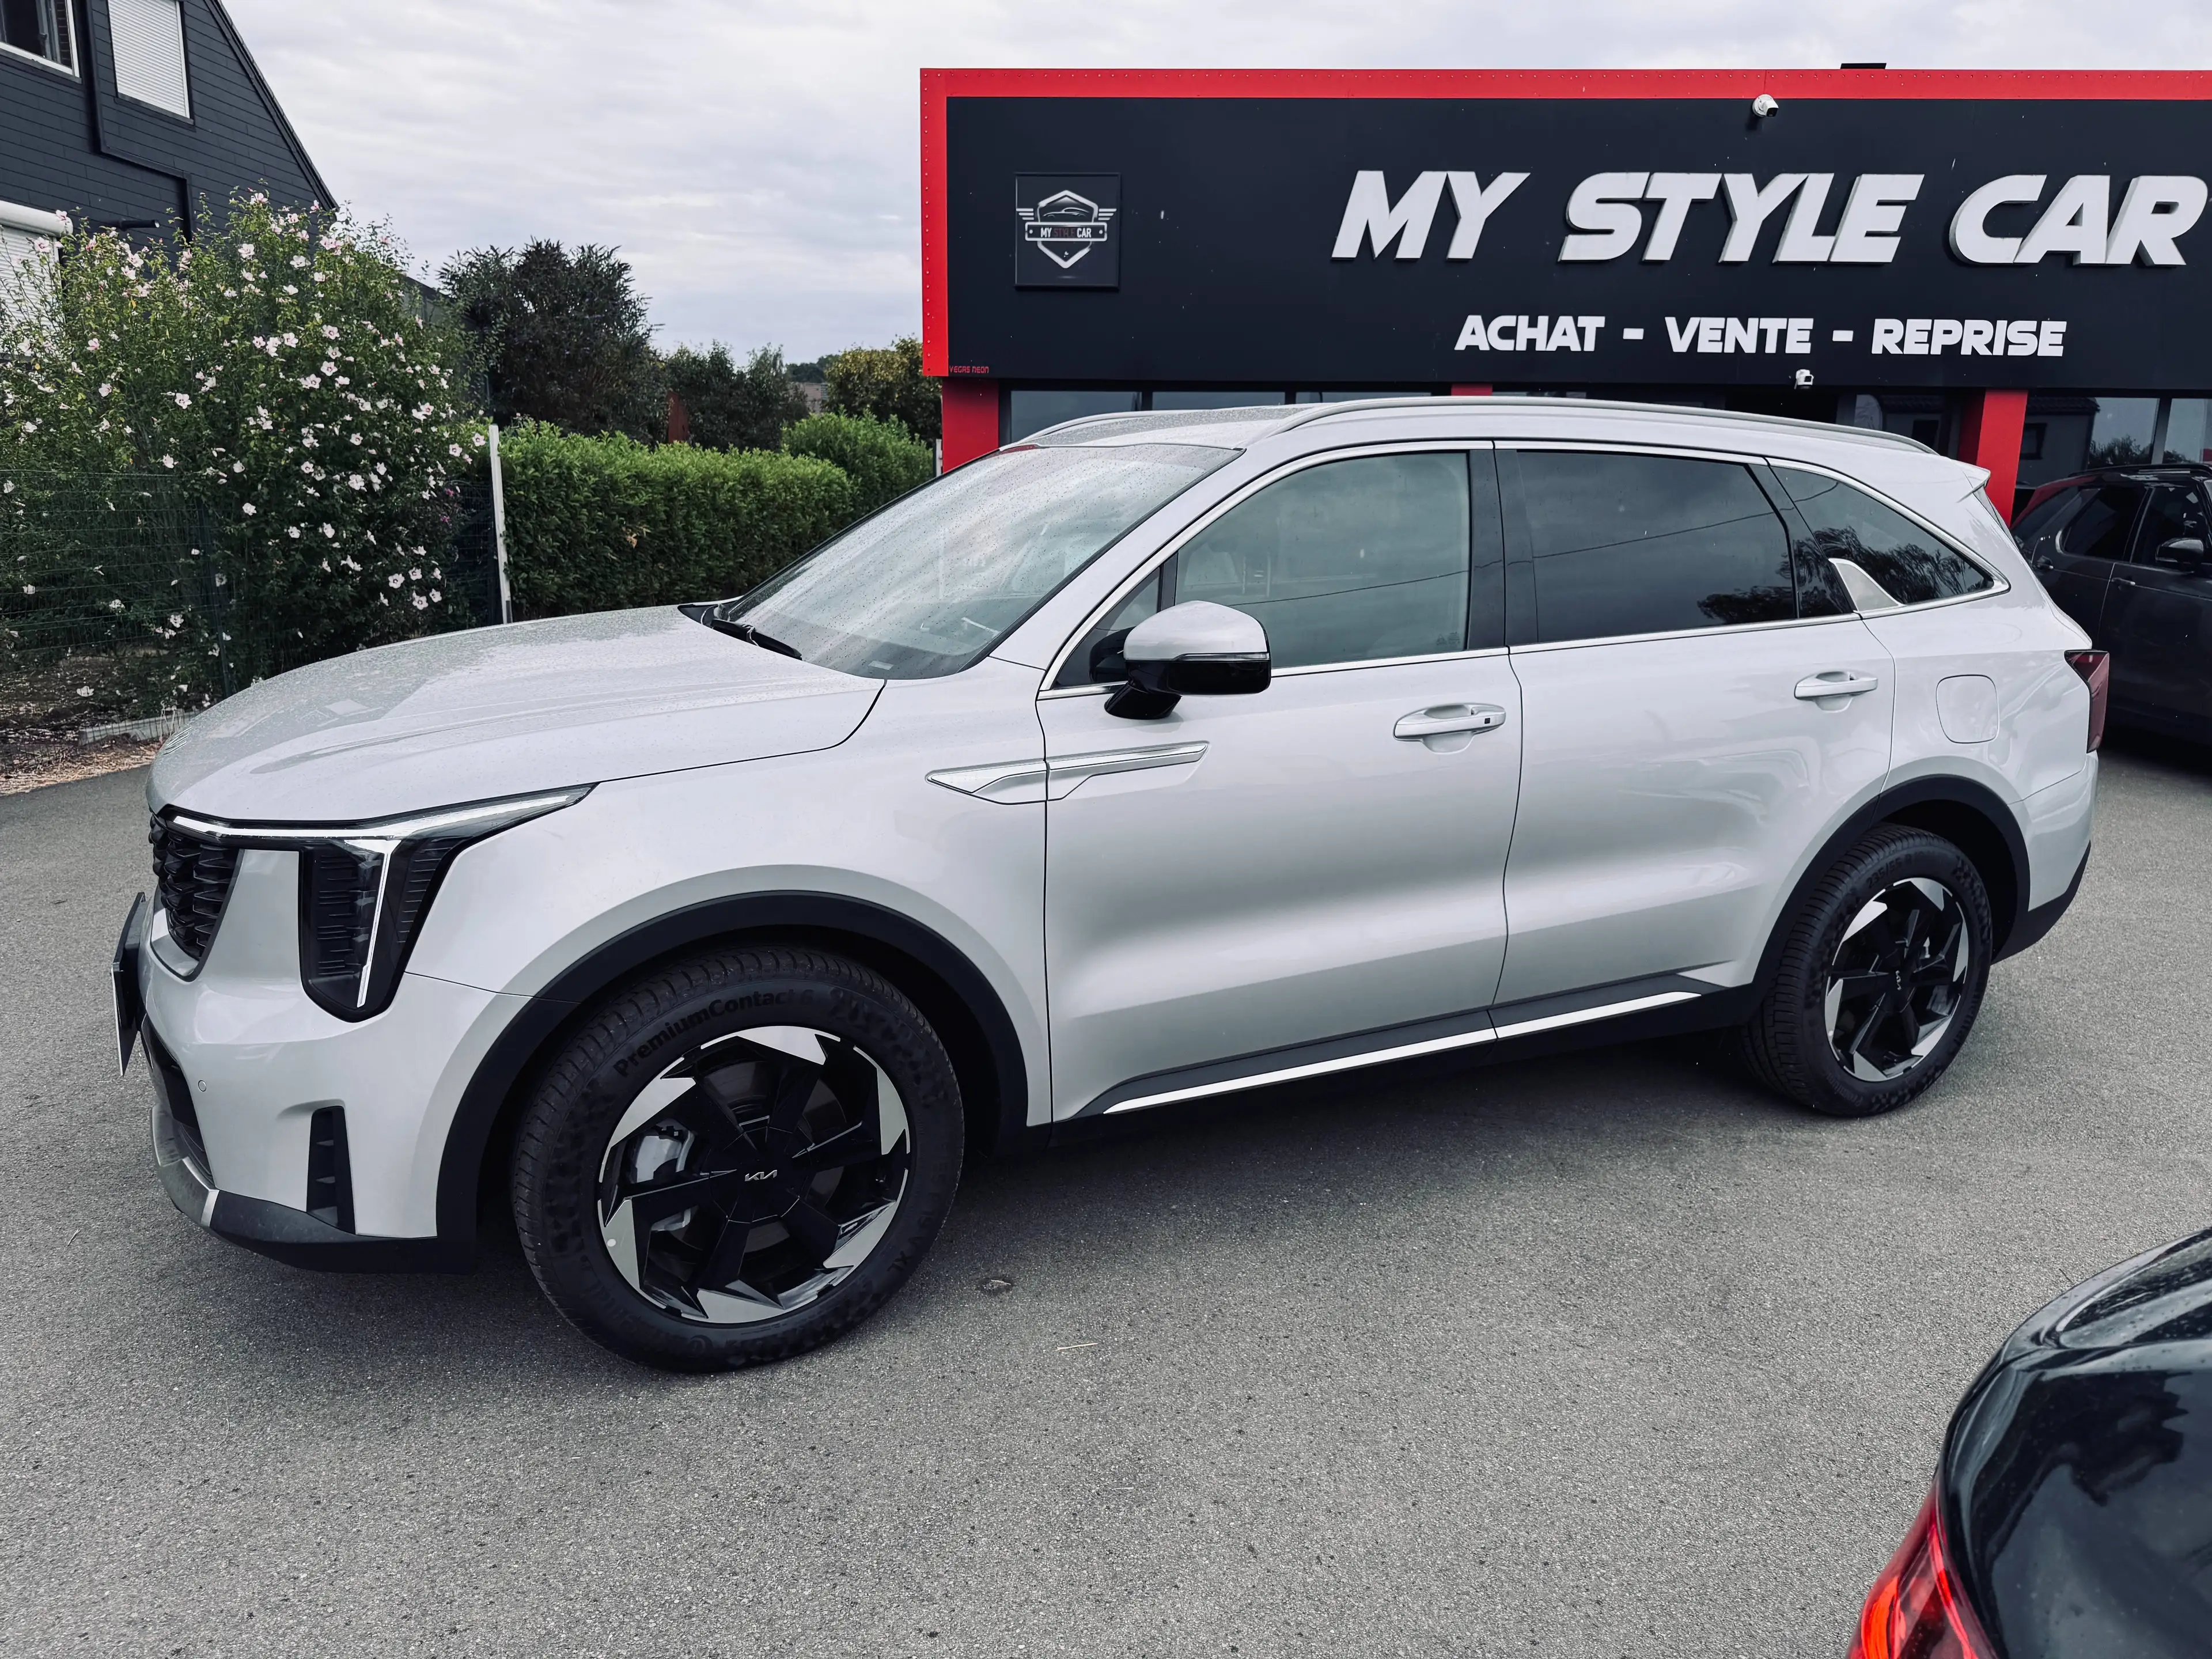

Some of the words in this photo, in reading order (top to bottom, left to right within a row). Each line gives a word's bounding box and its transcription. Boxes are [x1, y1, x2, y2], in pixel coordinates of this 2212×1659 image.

[1040, 227, 1052, 238] MY
[1052, 228, 1075, 238] STYLE
[1077, 228, 1092, 238] CAR
[1331, 171, 1531, 260] MY
[1558, 172, 1925, 264] STYLE
[1948, 175, 2209, 266] CAR
[1454, 315, 1605, 351] ACHAT
[1623, 328, 1644, 340] -
[1665, 317, 1814, 354] VENTE
[1832, 329, 1854, 342] -
[1871, 318, 2067, 357] REPRISE
[613, 987, 795, 1078] PremiumContact
